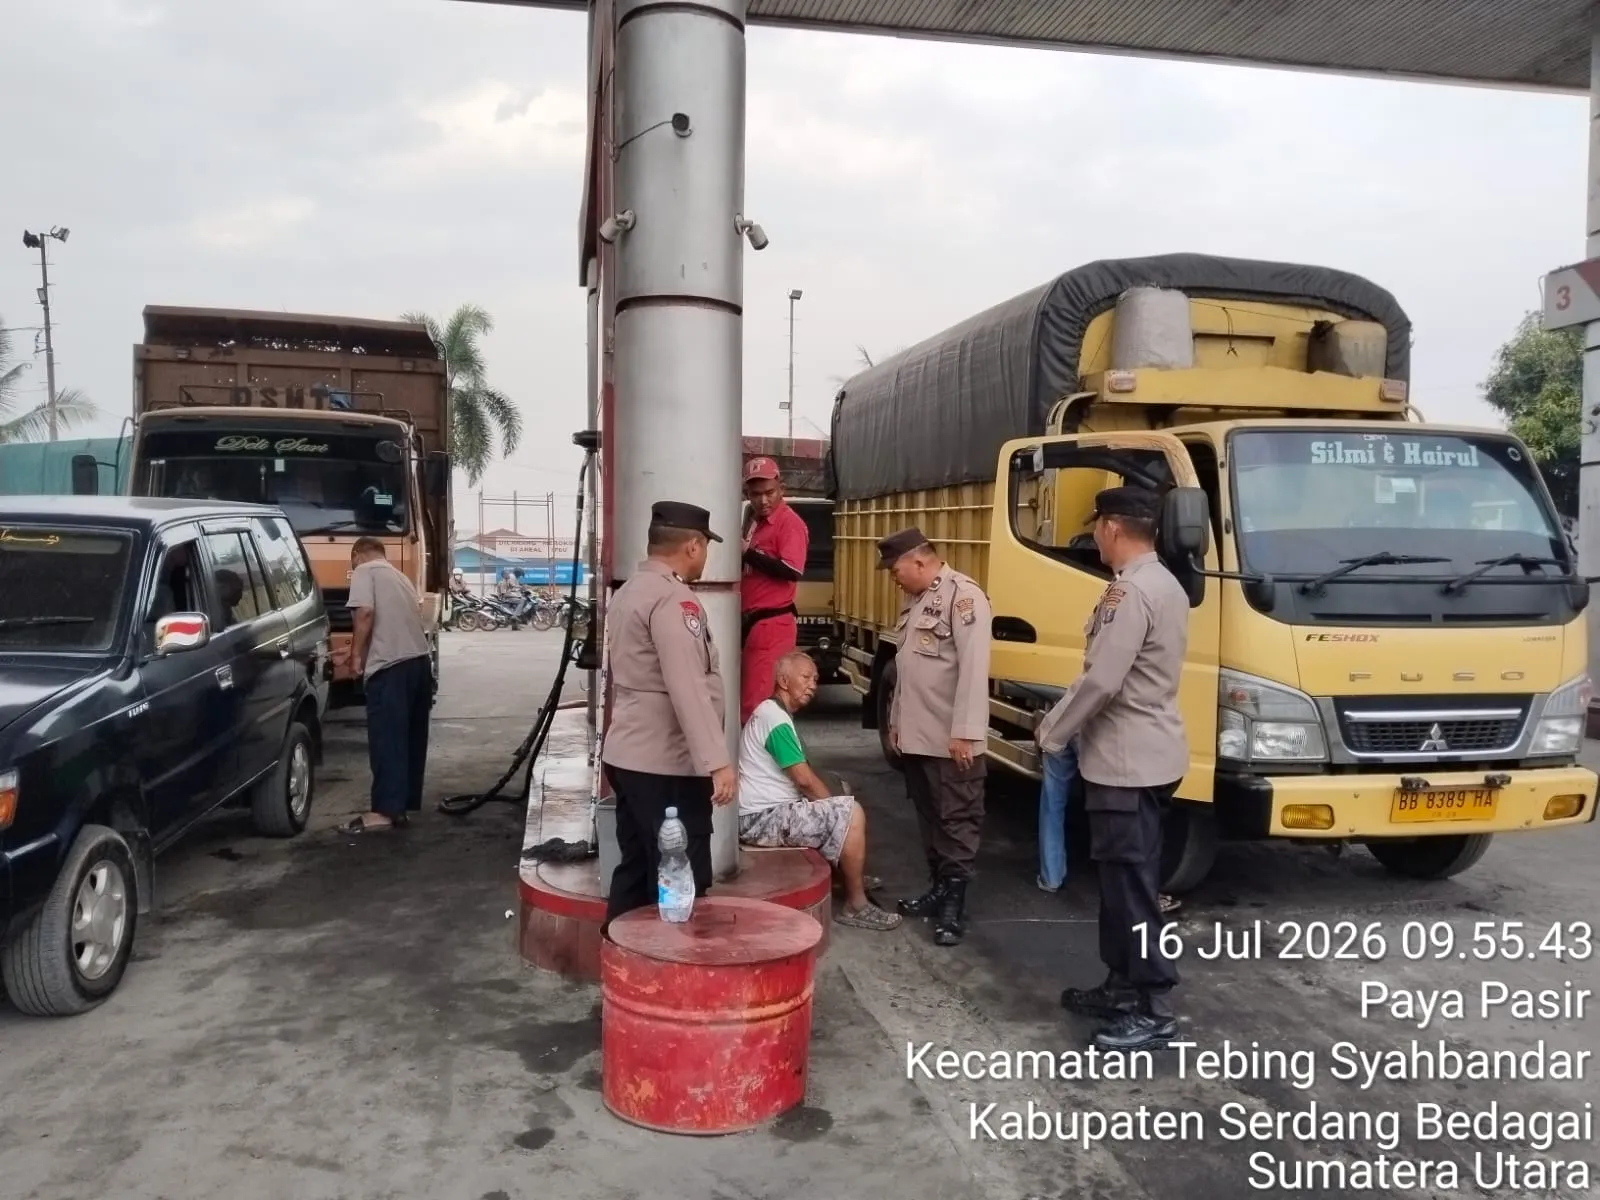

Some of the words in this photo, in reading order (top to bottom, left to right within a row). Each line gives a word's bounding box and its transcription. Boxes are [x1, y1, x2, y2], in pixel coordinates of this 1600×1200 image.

[1556, 285, 1571, 311] 3
[1311, 441, 1376, 464] Silmi
[1383, 442, 1396, 464] &
[1402, 442, 1479, 467] Hairul
[1349, 671, 1525, 683] FUSO
[1399, 791, 1419, 810] BB
[1426, 790, 1466, 809] 8389
[1473, 789, 1493, 808] HA
